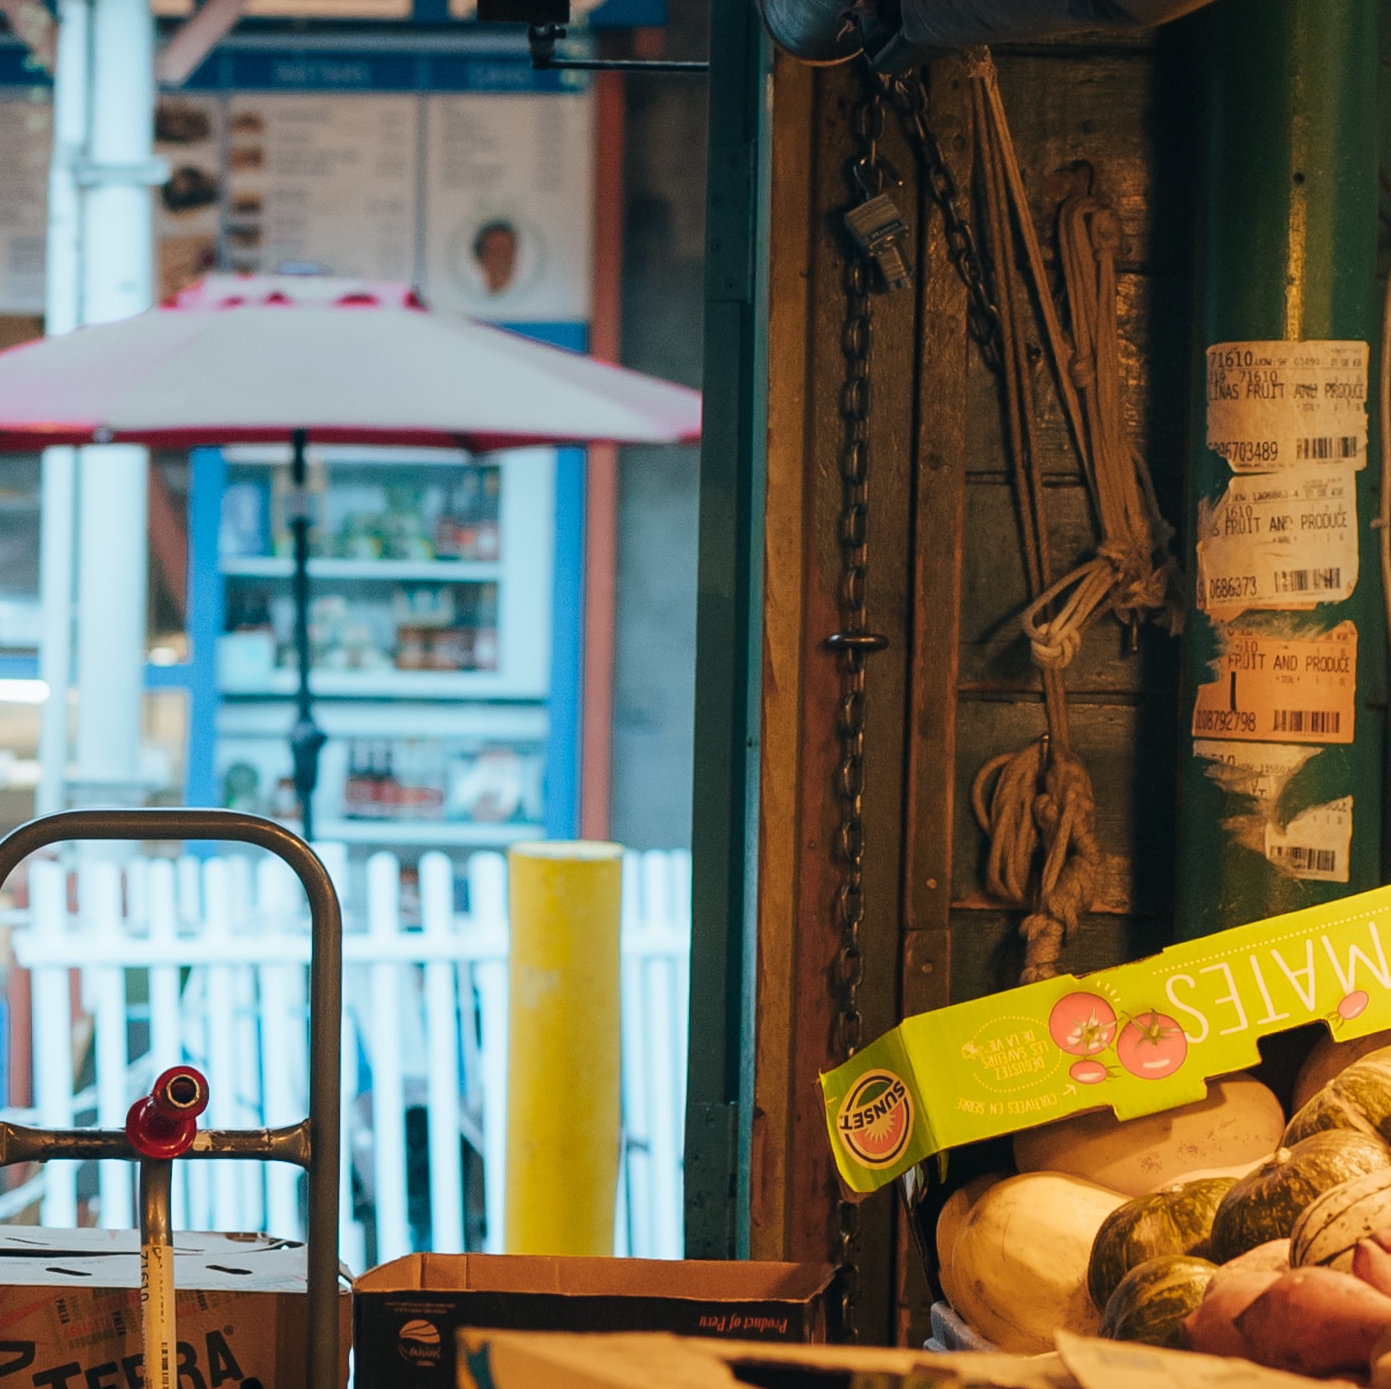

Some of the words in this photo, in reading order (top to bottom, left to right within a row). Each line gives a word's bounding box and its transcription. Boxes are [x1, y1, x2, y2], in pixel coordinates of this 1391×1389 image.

[1246, 383, 1285, 399] FRUIT
[1324, 382, 1364, 399] PRODUCE
[1208, 441, 1278, 462] 96703489
[1224, 516, 1261, 536] FRUIT
[1301, 511, 1348, 529] PRODUCE
[1273, 654, 1298, 672] AND
[1306, 654, 1351, 673] PRODUCE
[1165, 920, 1391, 1045] MATES
[1005, 1033, 1019, 1047] LA
[1029, 1040, 1050, 1056] LES
[980, 1045, 1027, 1069] SAVEURS
[839, 1080, 906, 1132] SUNSET
[954, 1097, 985, 1115] SERRE
[989, 1102, 1004, 1115] EN
[698, 1316, 726, 1333] Peru
[728, 1312, 742, 1332] of
[742, 1317, 789, 1334] Product
